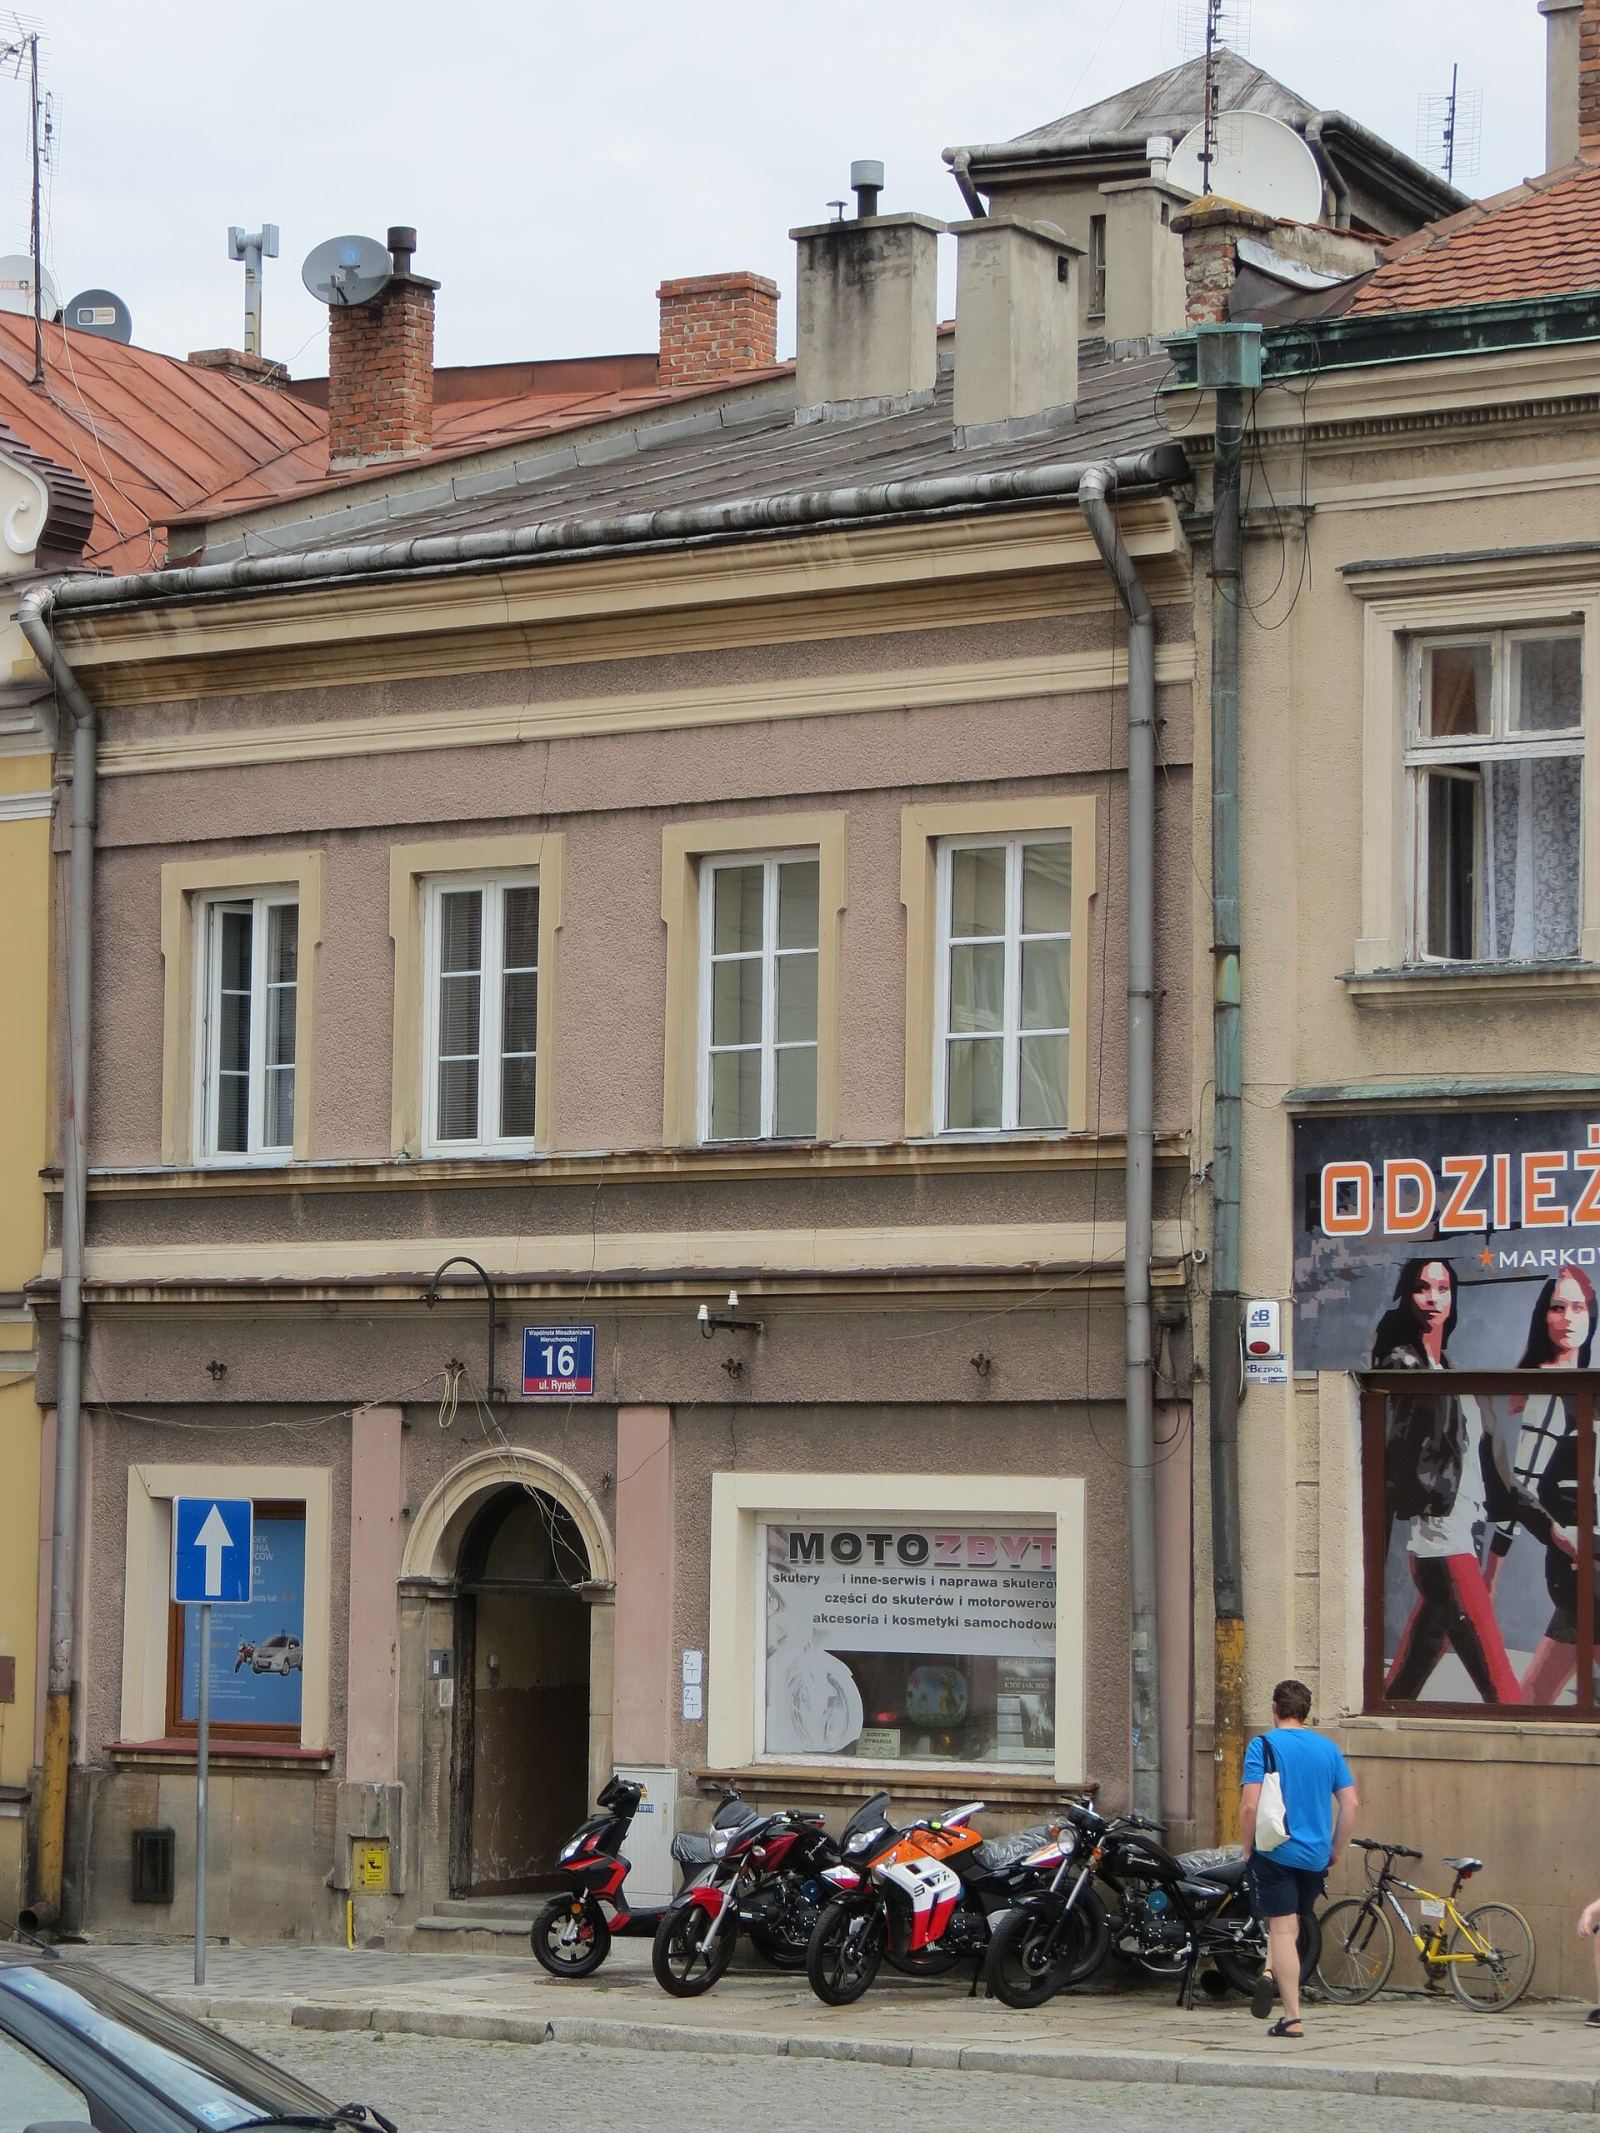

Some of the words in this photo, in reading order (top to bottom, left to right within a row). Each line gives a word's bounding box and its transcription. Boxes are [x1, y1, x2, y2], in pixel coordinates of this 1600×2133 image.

[1498, 1246, 1600, 1269] MARKO
[541, 1345, 575, 1376] 16
[539, 1380, 549, 1390] ul.
[551, 1379, 577, 1392] Rynek
[788, 1531, 1056, 1569] MOTOZBYT
[772, 1573, 821, 1586] skutery
[841, 1573, 847, 1585] i
[850, 1573, 927, 1586] inne-serwis
[931, 1575, 936, 1587] i
[939, 1577, 998, 1589] naprawa
[1002, 1578, 1056, 1590] skuteró
[824, 1592, 867, 1606] części
[871, 1593, 888, 1605] do
[892, 1594, 955, 1607] skuterów
[958, 1596, 963, 1607] i
[812, 1613, 880, 1625] akcesoria
[883, 1614, 888, 1625] i
[892, 1615, 960, 1629] kosmetyki
